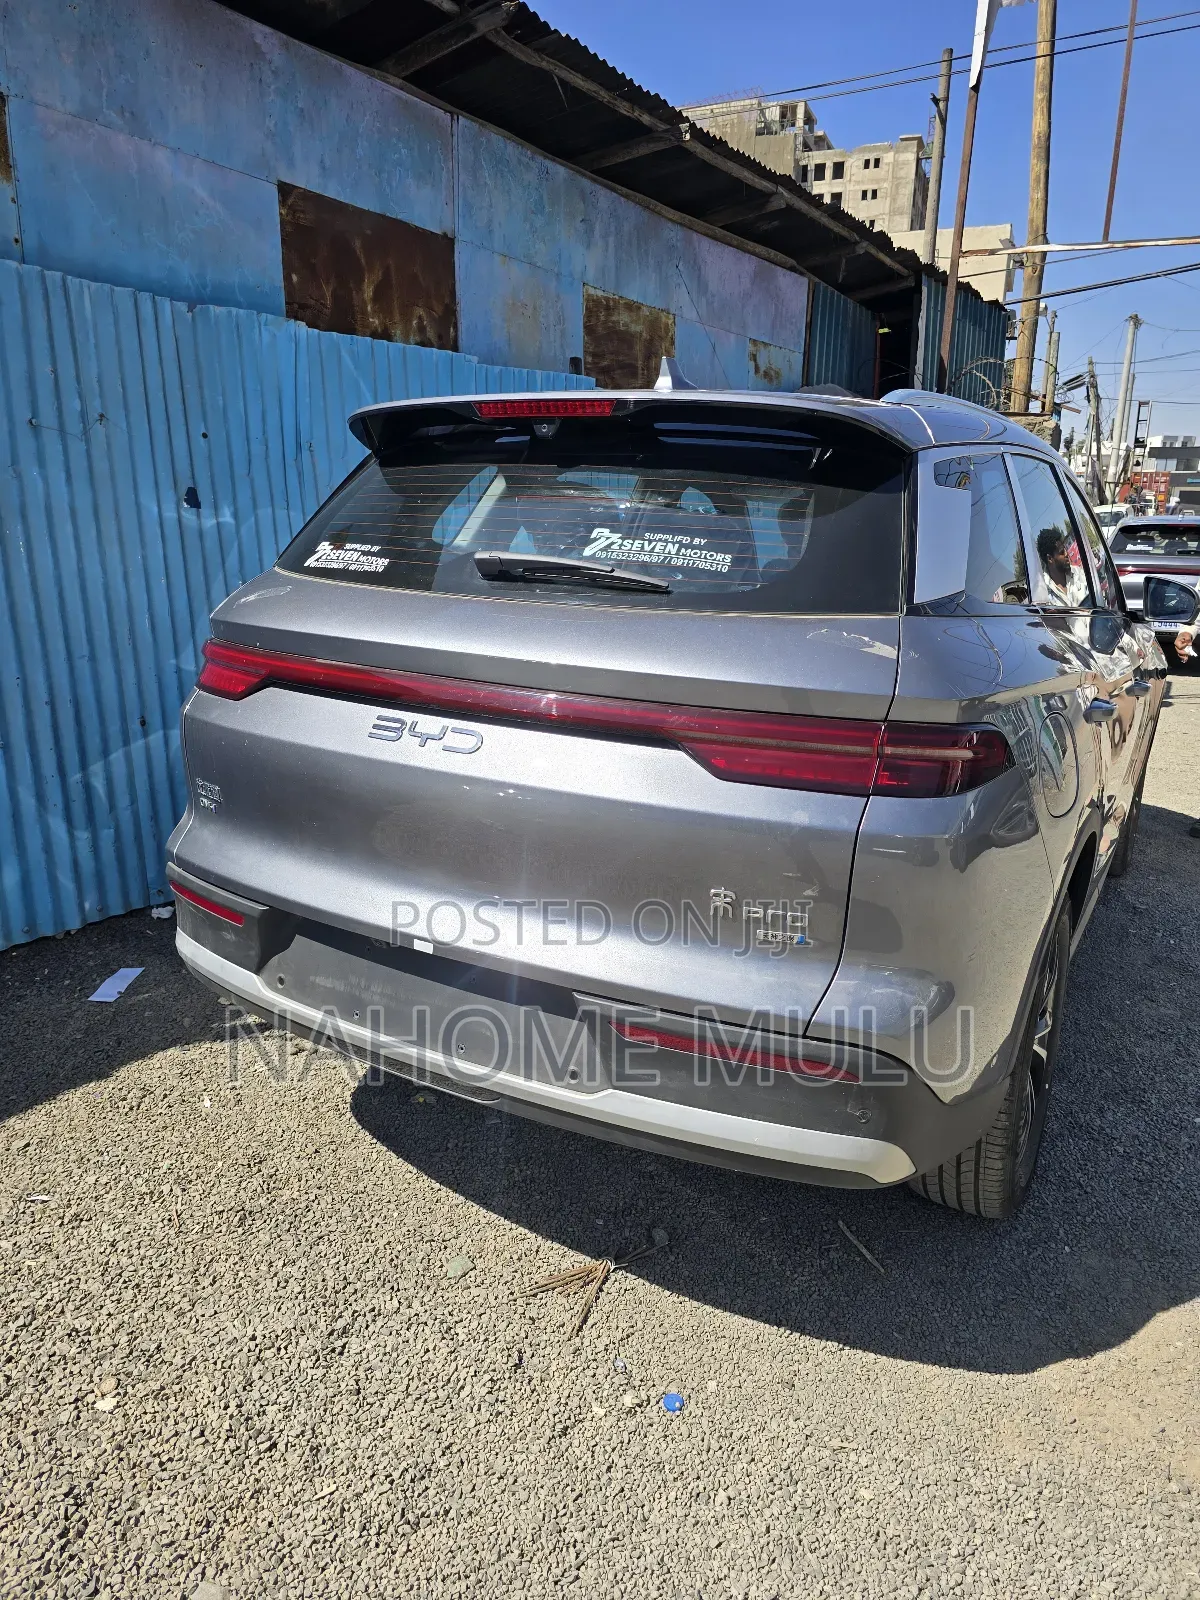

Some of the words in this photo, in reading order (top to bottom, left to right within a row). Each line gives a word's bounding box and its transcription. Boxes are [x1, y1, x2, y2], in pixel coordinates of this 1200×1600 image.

[644, 532, 690, 543] SUPPLIED
[693, 538, 708, 546] BY
[344, 543, 371, 551] SUPPLIED
[370, 545, 381, 553] BY
[680, 547, 733, 563] MOTORS
[358, 555, 389, 566] MOTORS
[671, 557, 729, 573] 0911705310
[368, 714, 483, 754] BYD
